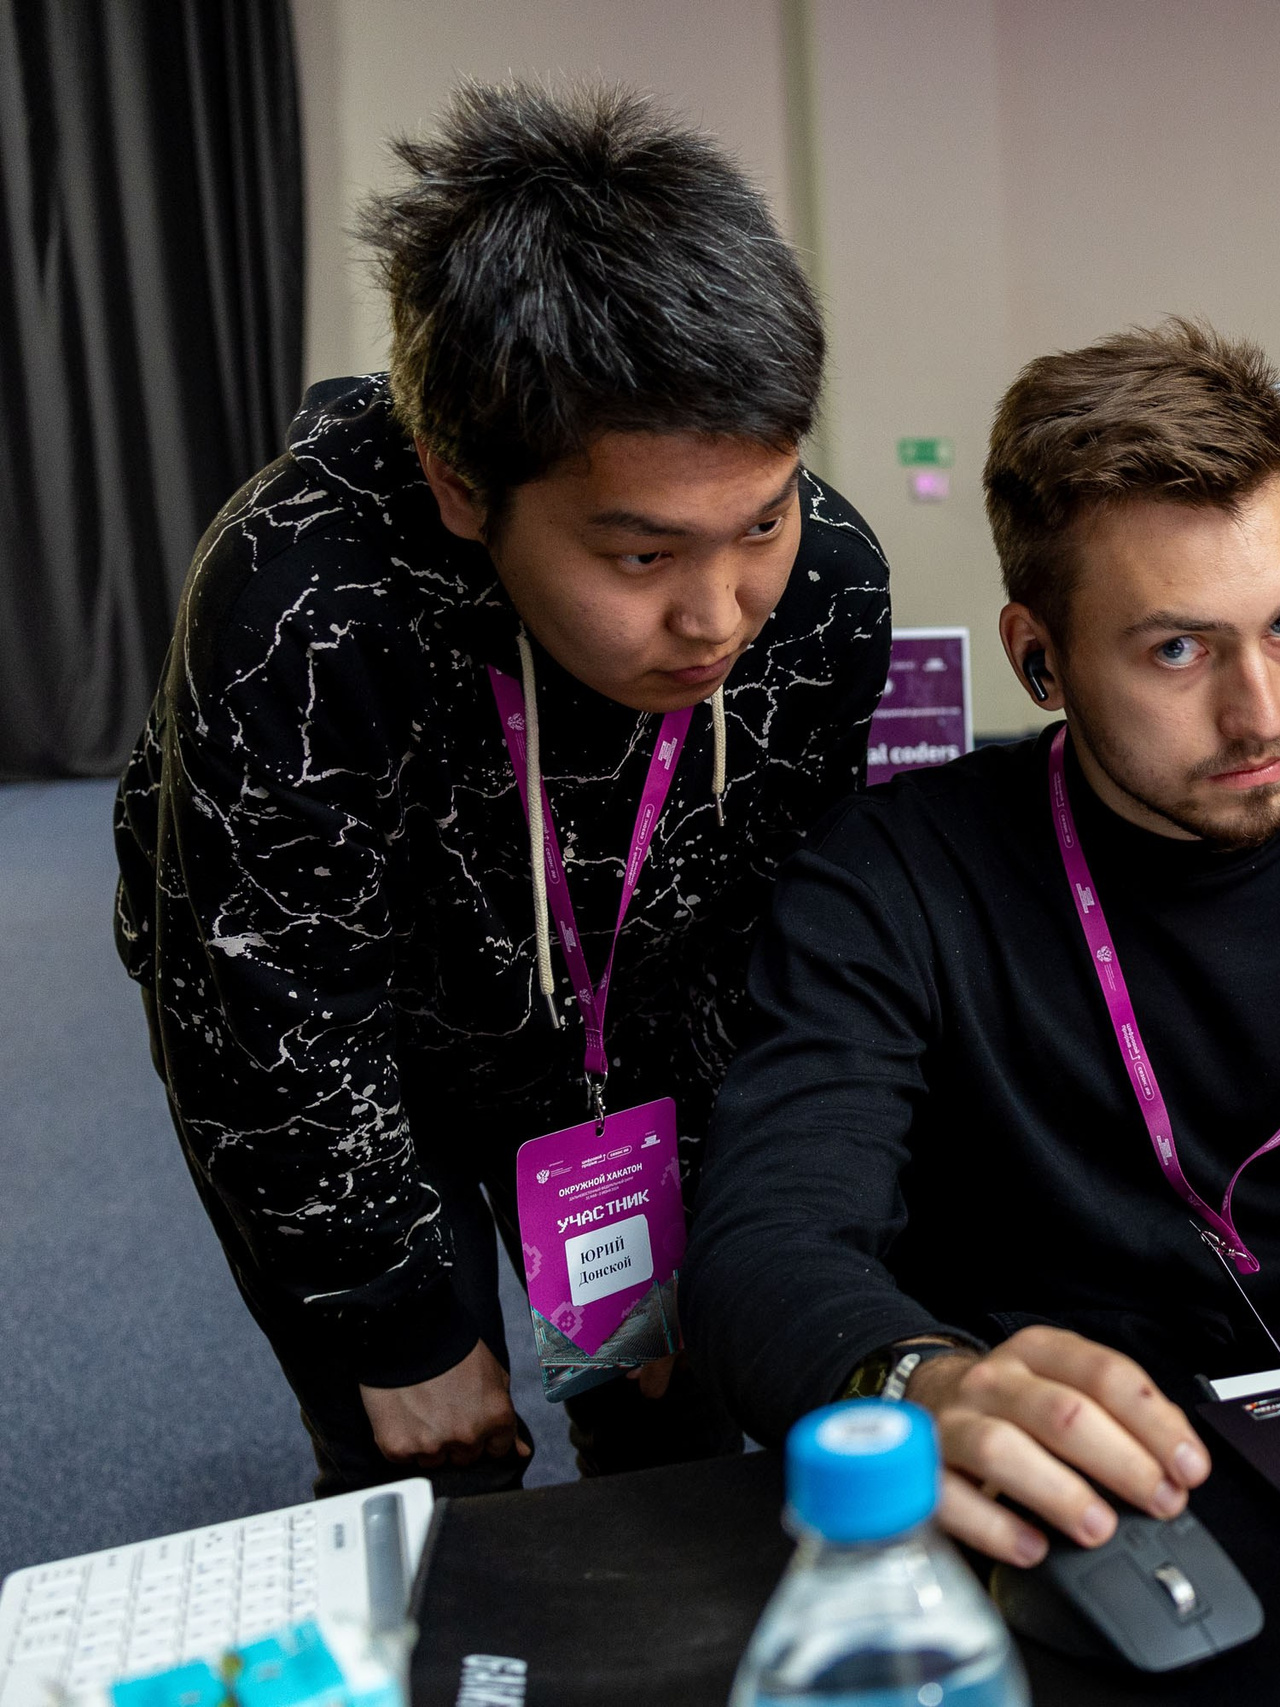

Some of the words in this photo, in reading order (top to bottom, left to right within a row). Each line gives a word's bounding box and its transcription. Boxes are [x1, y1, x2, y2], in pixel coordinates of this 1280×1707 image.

[558, 1173, 606, 1197] ОКРУЖНОЙ
[606, 1162, 643, 1182] ХАКАТОН
[557, 1189, 650, 1234] УЧАСТНИК
[580, 1235, 625, 1264] ЮРИЙ
[578, 1255, 632, 1287] Донской
